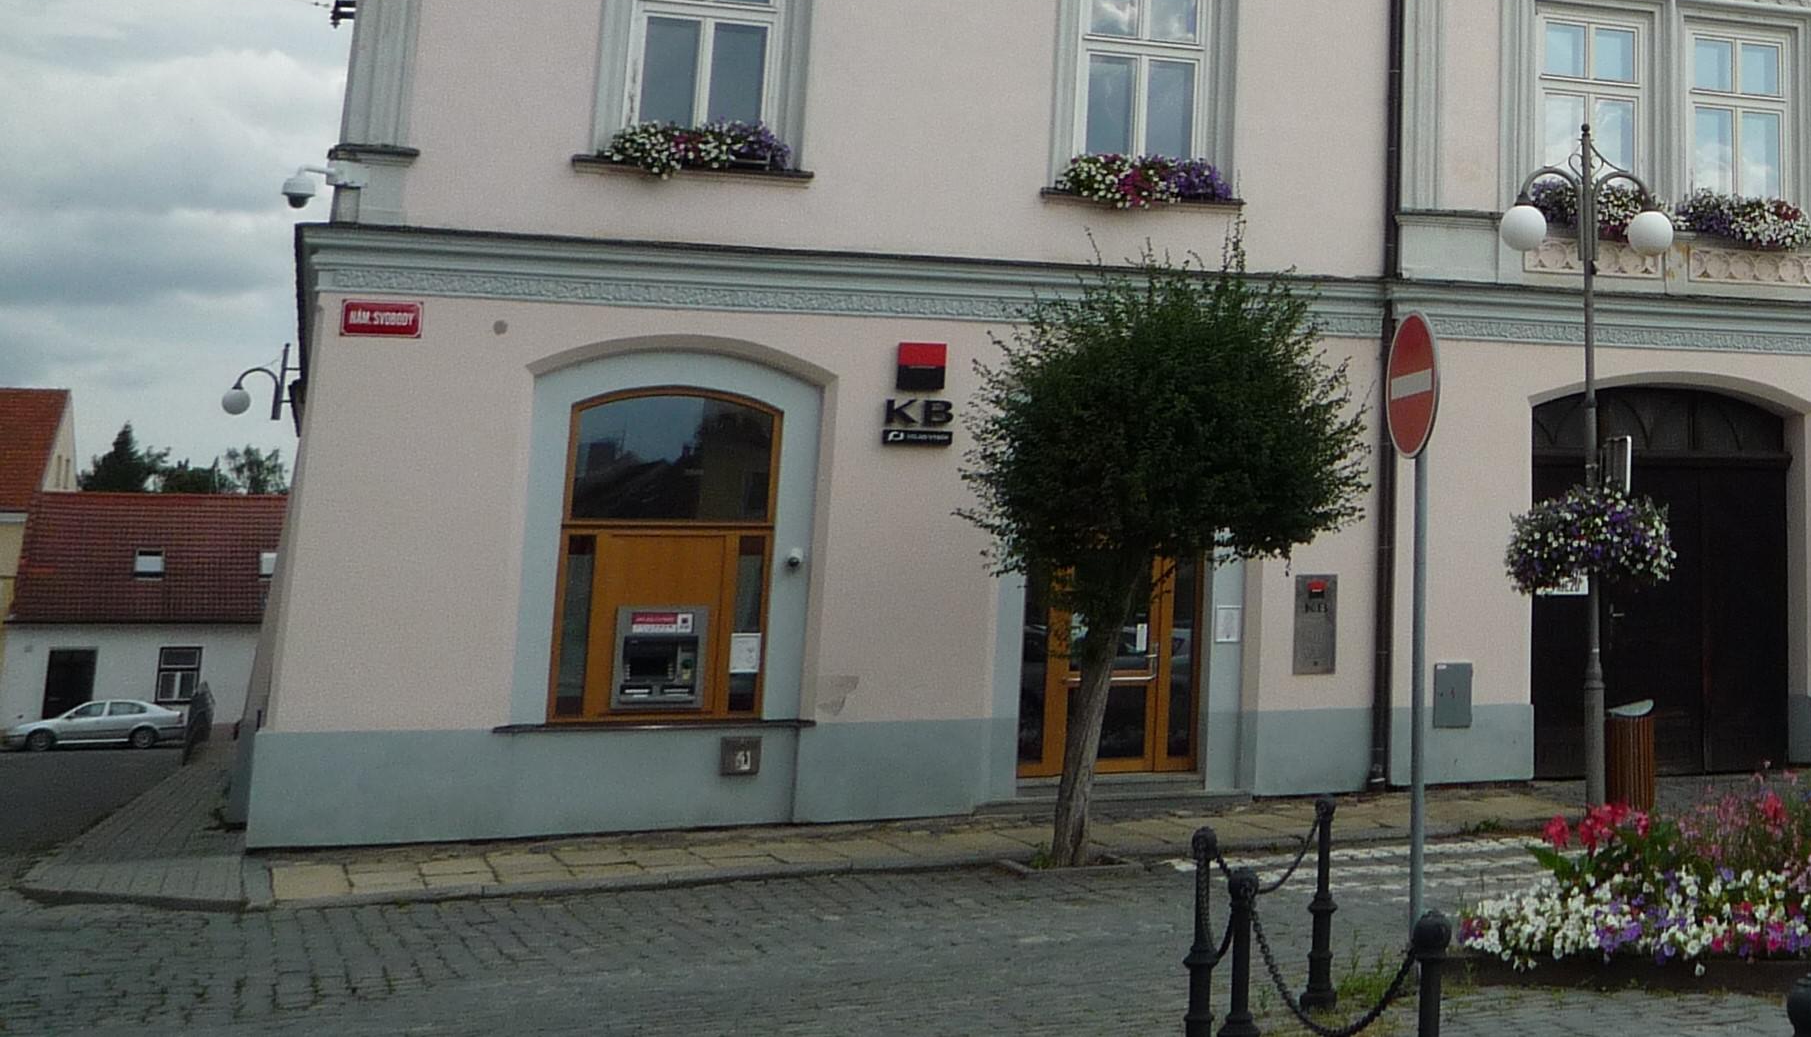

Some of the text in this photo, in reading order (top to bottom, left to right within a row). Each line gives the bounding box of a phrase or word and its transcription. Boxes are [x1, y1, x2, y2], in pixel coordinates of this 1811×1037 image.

[348, 307, 417, 327] NÁM. SVOBODY
[884, 398, 954, 425] KB
